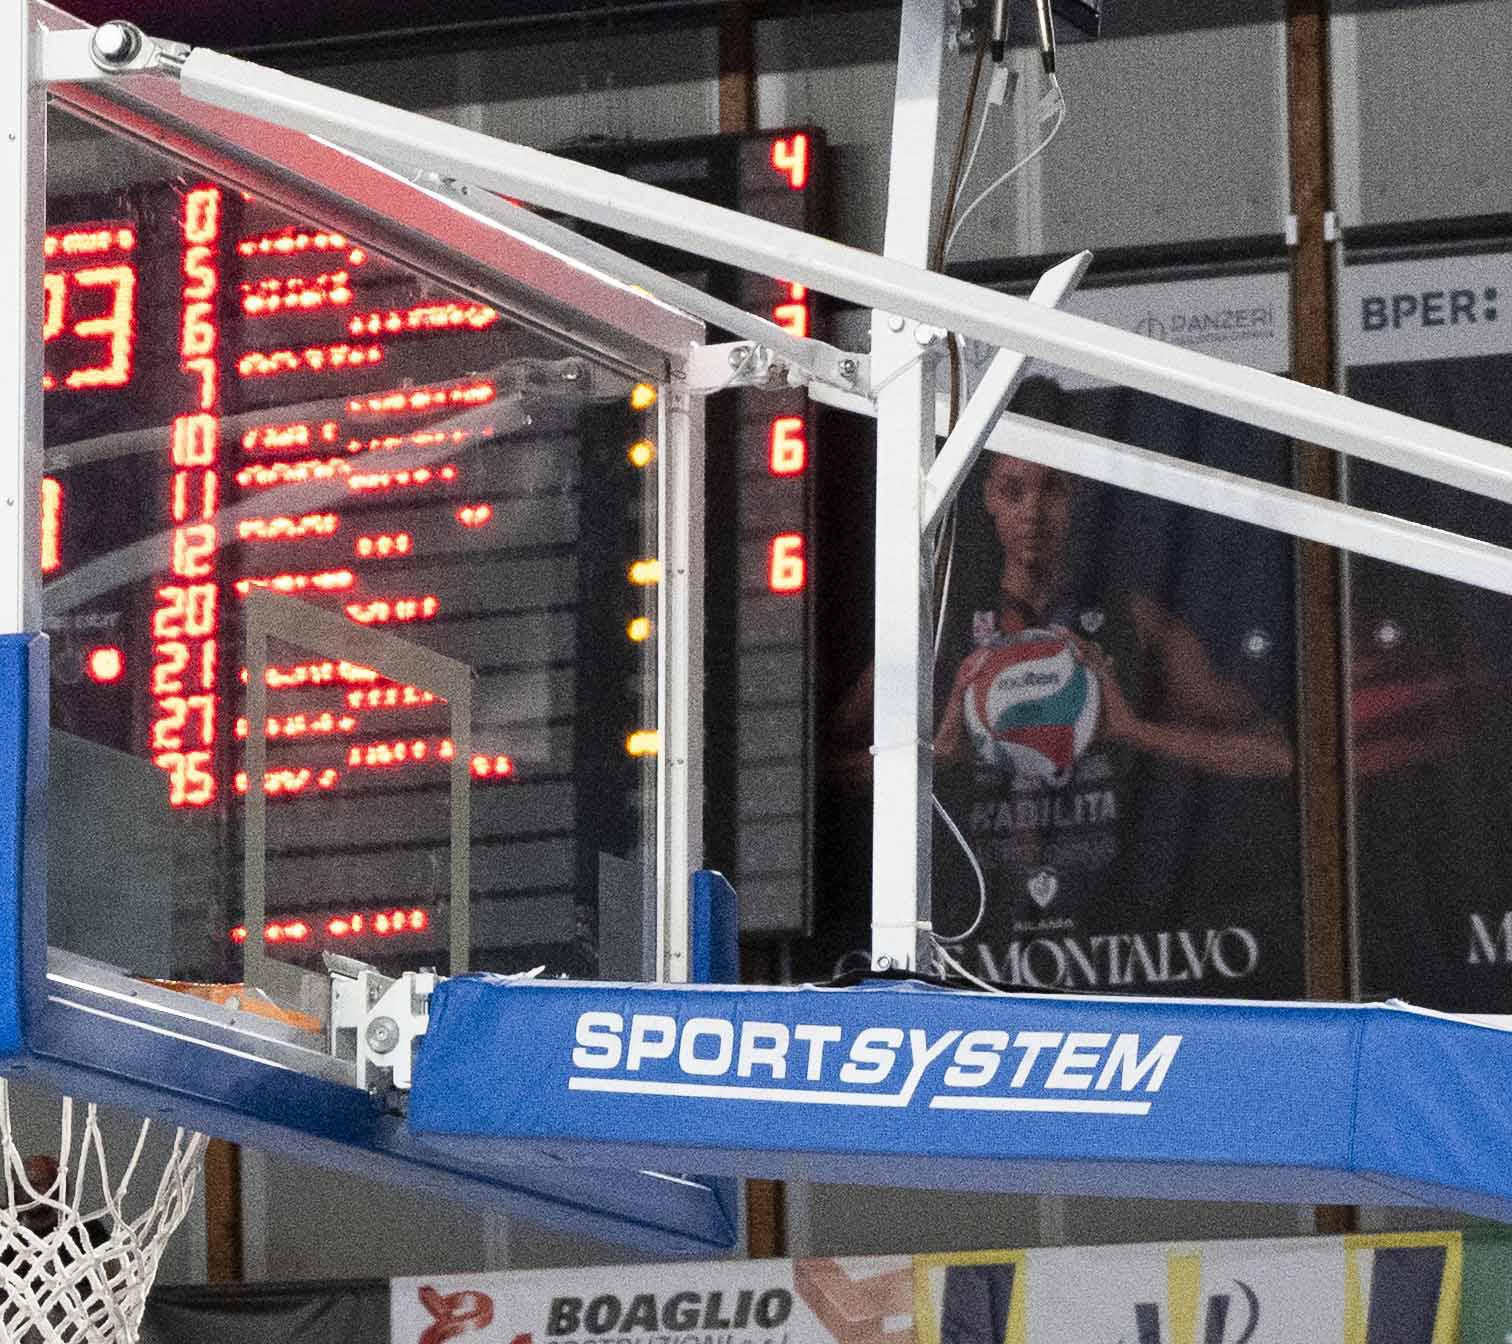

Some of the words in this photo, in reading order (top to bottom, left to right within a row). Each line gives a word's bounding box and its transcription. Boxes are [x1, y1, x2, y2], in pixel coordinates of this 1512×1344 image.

[771, 133, 808, 188] 4
[770, 418, 806, 477] 6
[770, 535, 806, 594] 6
[977, 926, 1259, 987] MONTALVO
[545, 1287, 794, 1337] BOAGLIO
